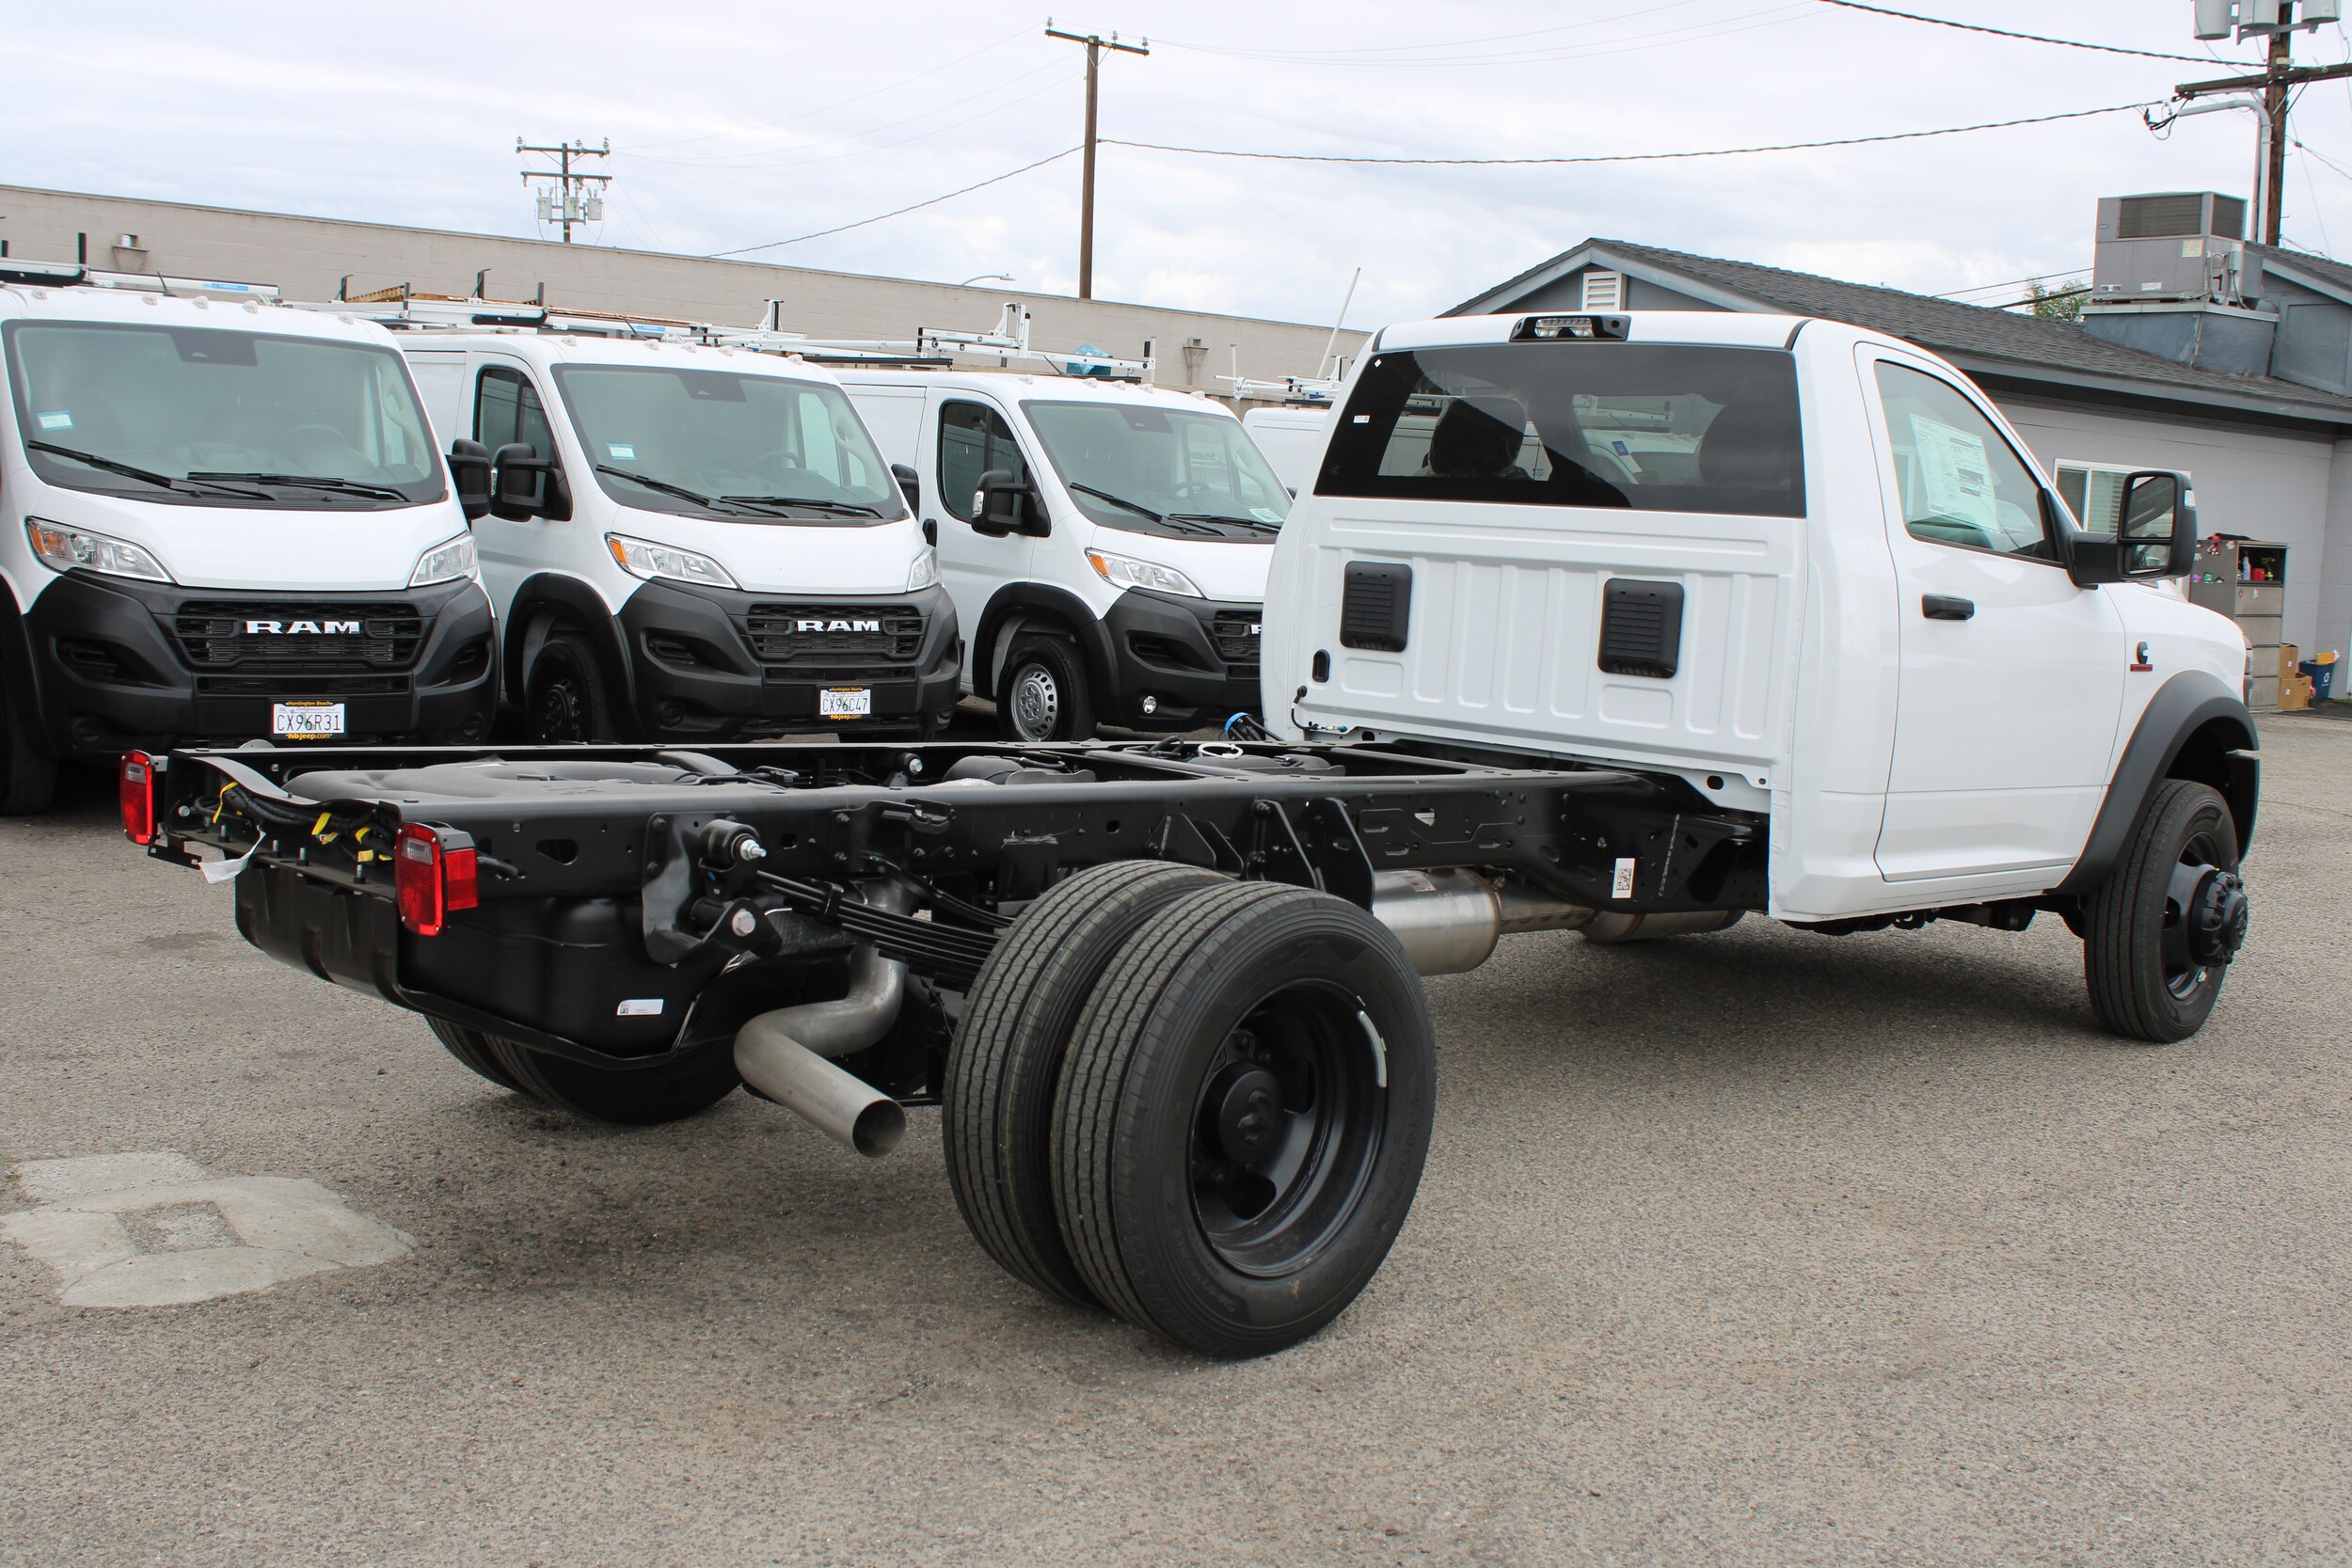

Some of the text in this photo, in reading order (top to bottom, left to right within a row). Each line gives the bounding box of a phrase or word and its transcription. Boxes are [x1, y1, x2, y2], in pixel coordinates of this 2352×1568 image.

[246, 620, 359, 634] RAM
[797, 620, 880, 632] RAM
[822, 698, 868, 712] CX96C47
[277, 714, 341, 731] CX96R31
